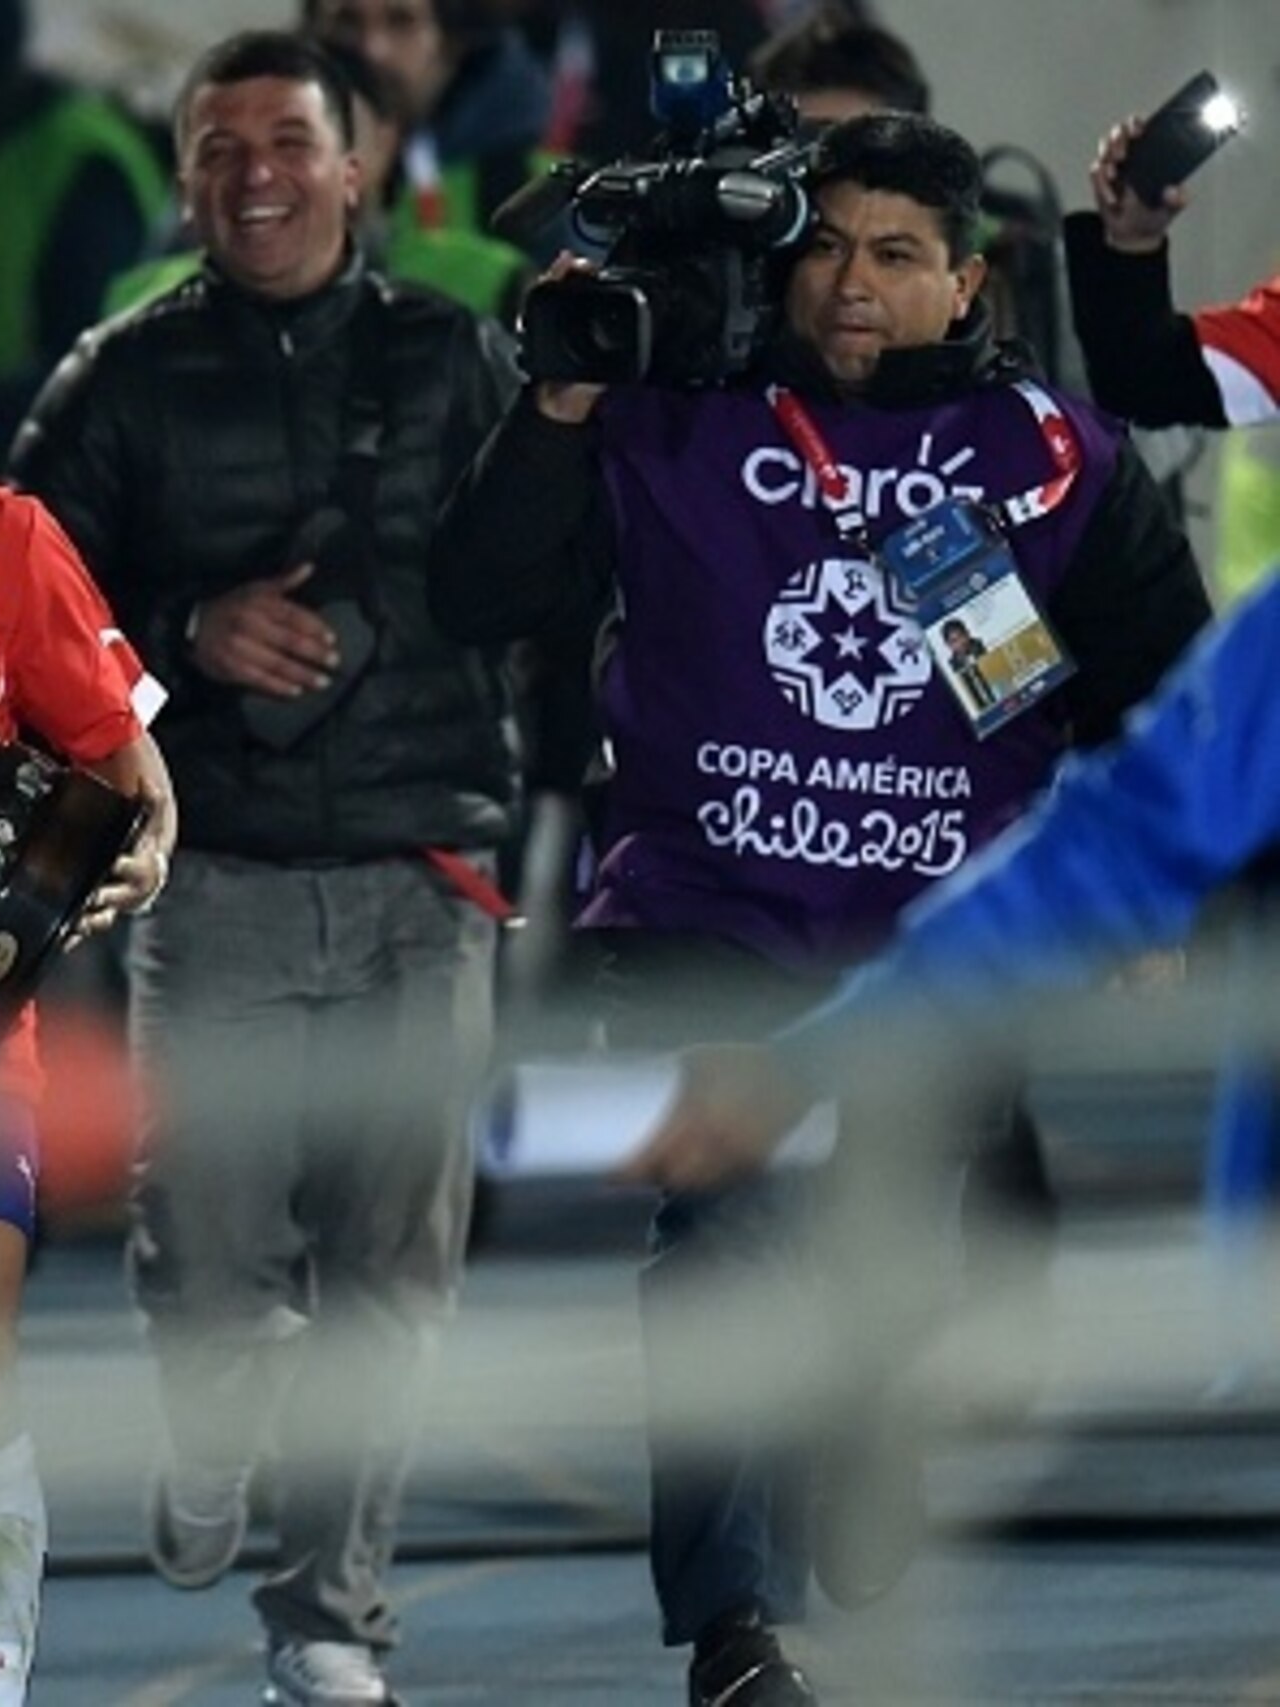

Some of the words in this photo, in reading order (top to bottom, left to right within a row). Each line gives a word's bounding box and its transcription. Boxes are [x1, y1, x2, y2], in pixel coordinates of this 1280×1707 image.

[742, 446, 946, 518] Claro
[697, 741, 799, 785] COPA
[805, 754, 971, 799] AMÉRICA
[860, 810, 967, 876] 2015
